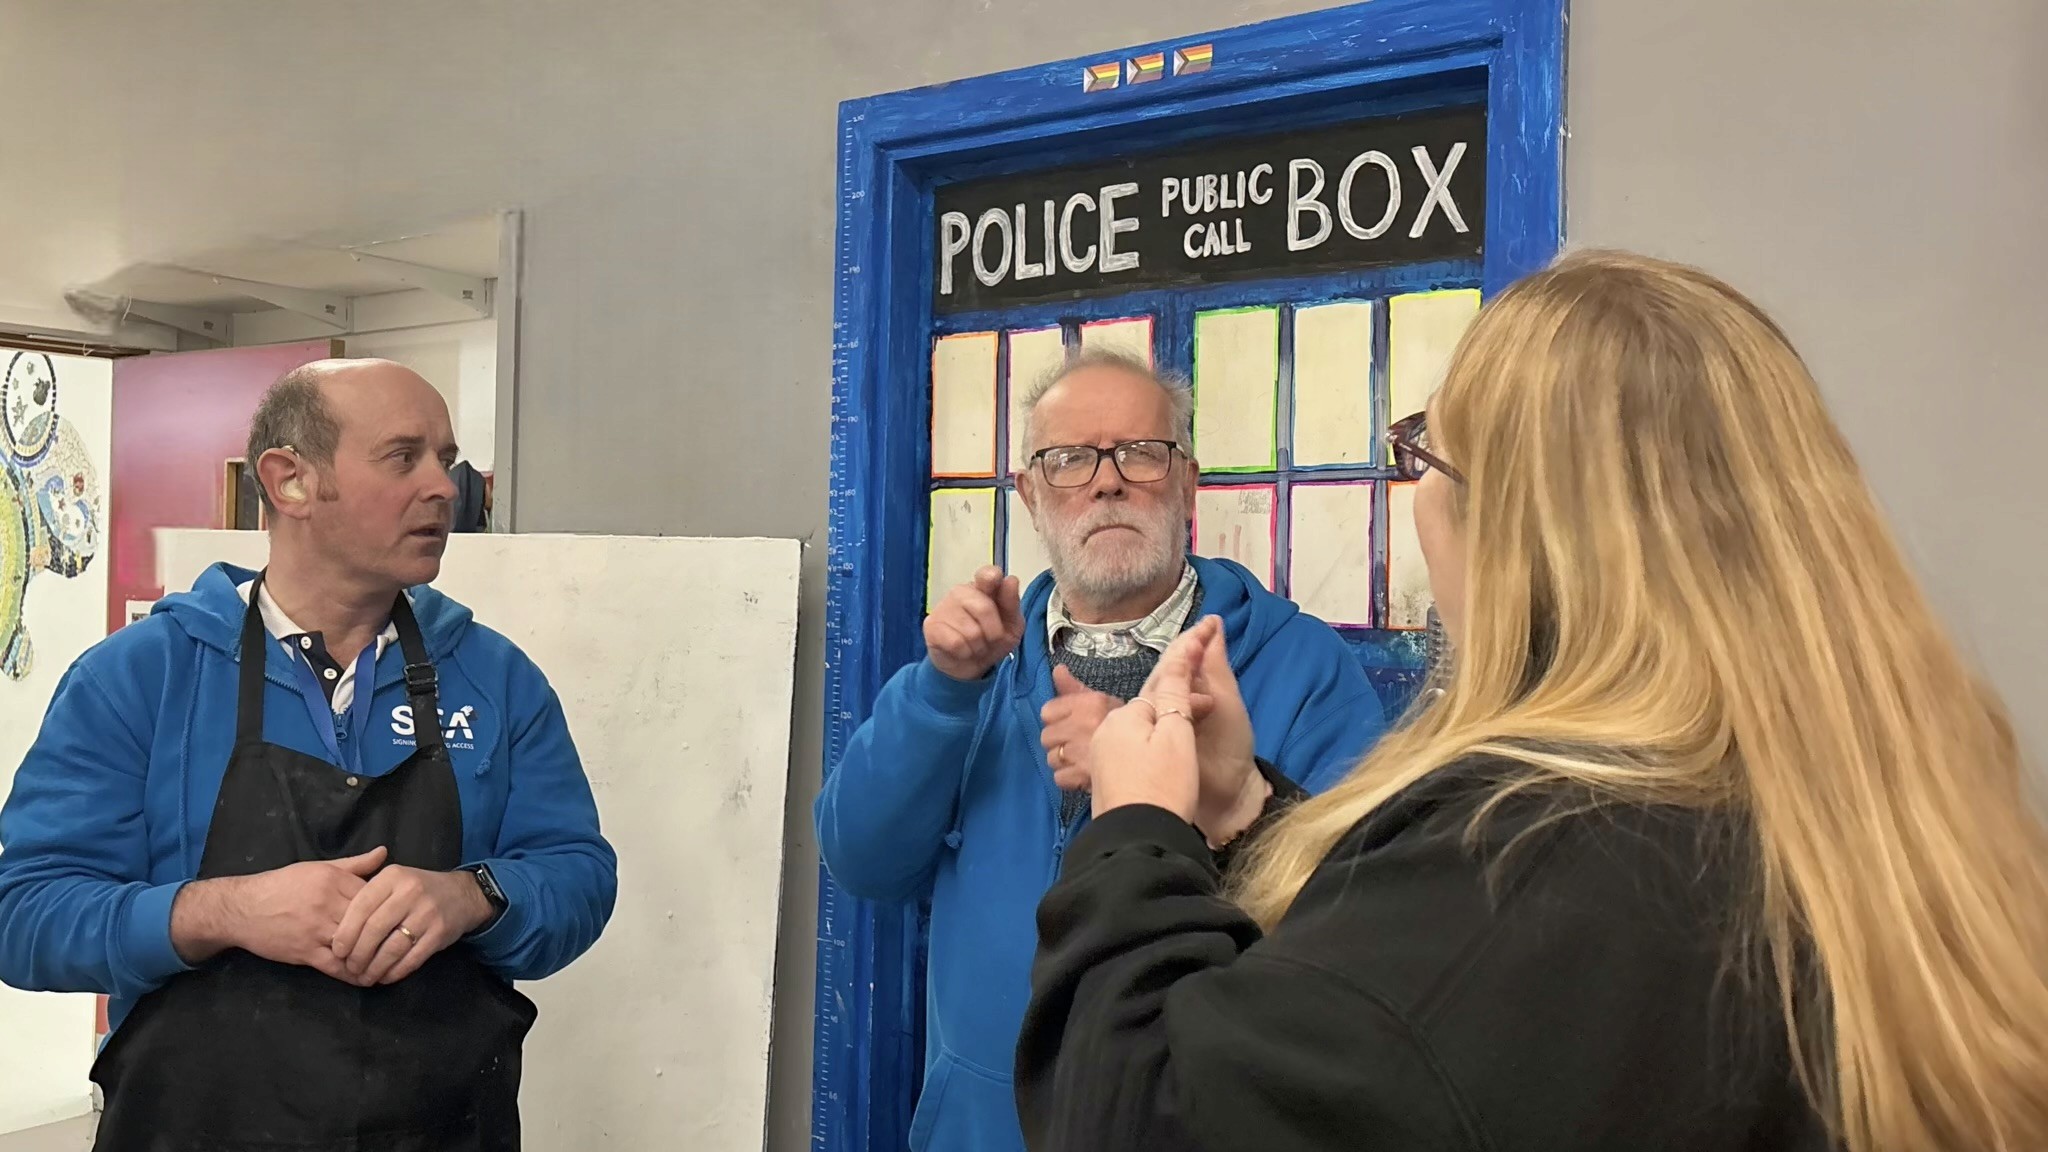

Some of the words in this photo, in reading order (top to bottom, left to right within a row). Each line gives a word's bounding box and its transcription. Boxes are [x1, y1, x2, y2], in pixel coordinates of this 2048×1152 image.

[851, 190, 865, 199] 200
[1161, 163, 1274, 218] PUBLIC
[1287, 142, 1469, 252] BOX
[940, 182, 1140, 295] POLICE
[1183, 218, 1251, 259] CALL
[843, 562, 854, 570] 150
[391, 705, 474, 739] SA
[451, 742, 475, 750] ACCESS
[833, 938, 846, 948] 100
